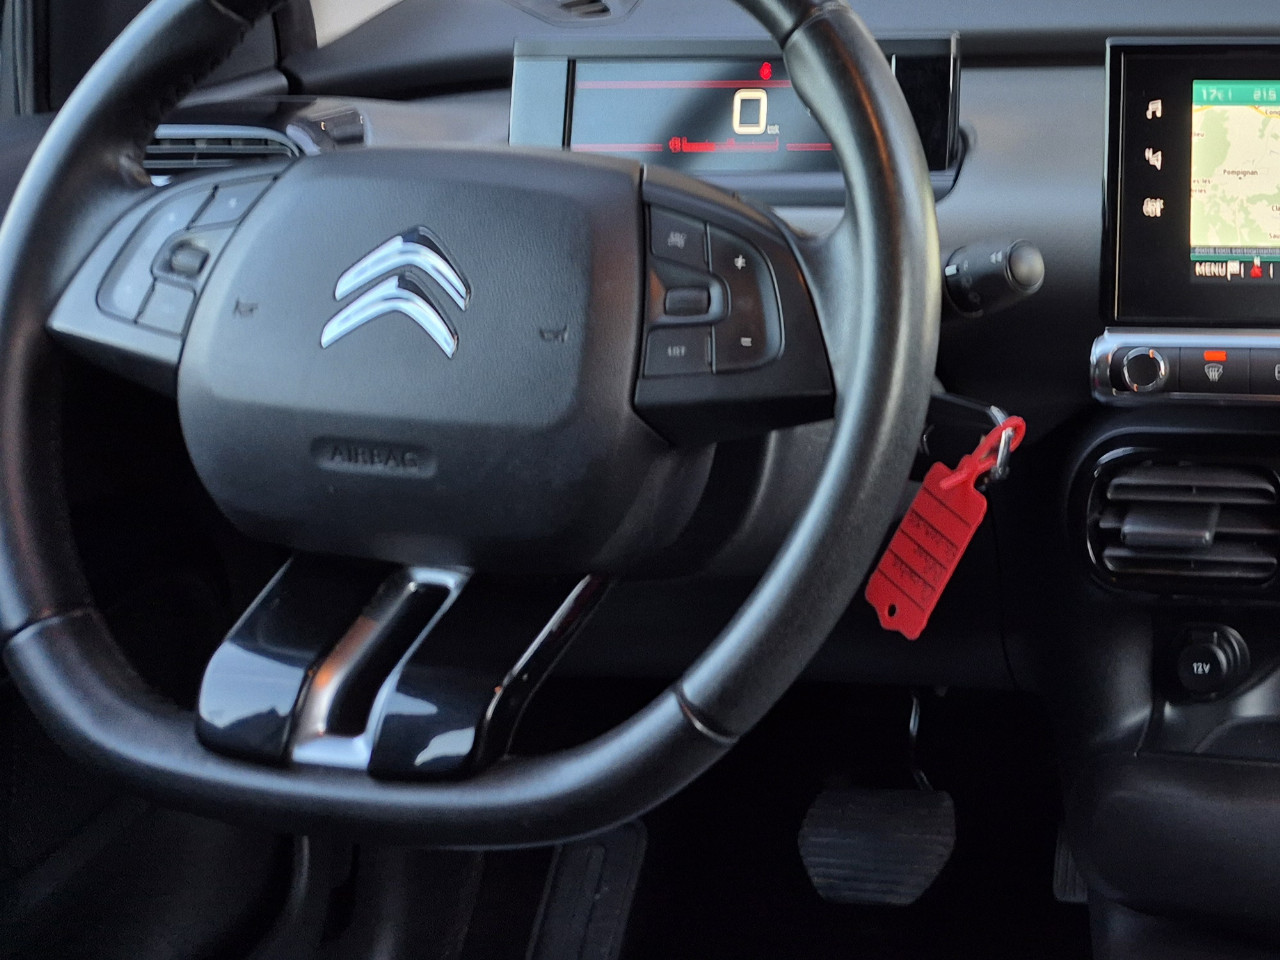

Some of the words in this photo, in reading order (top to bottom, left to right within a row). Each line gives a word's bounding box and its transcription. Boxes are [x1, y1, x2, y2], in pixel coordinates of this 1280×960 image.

[733, 88, 768, 135] 0
[1195, 261, 1227, 277] MENU
[1192, 662, 1211, 675] 12V
